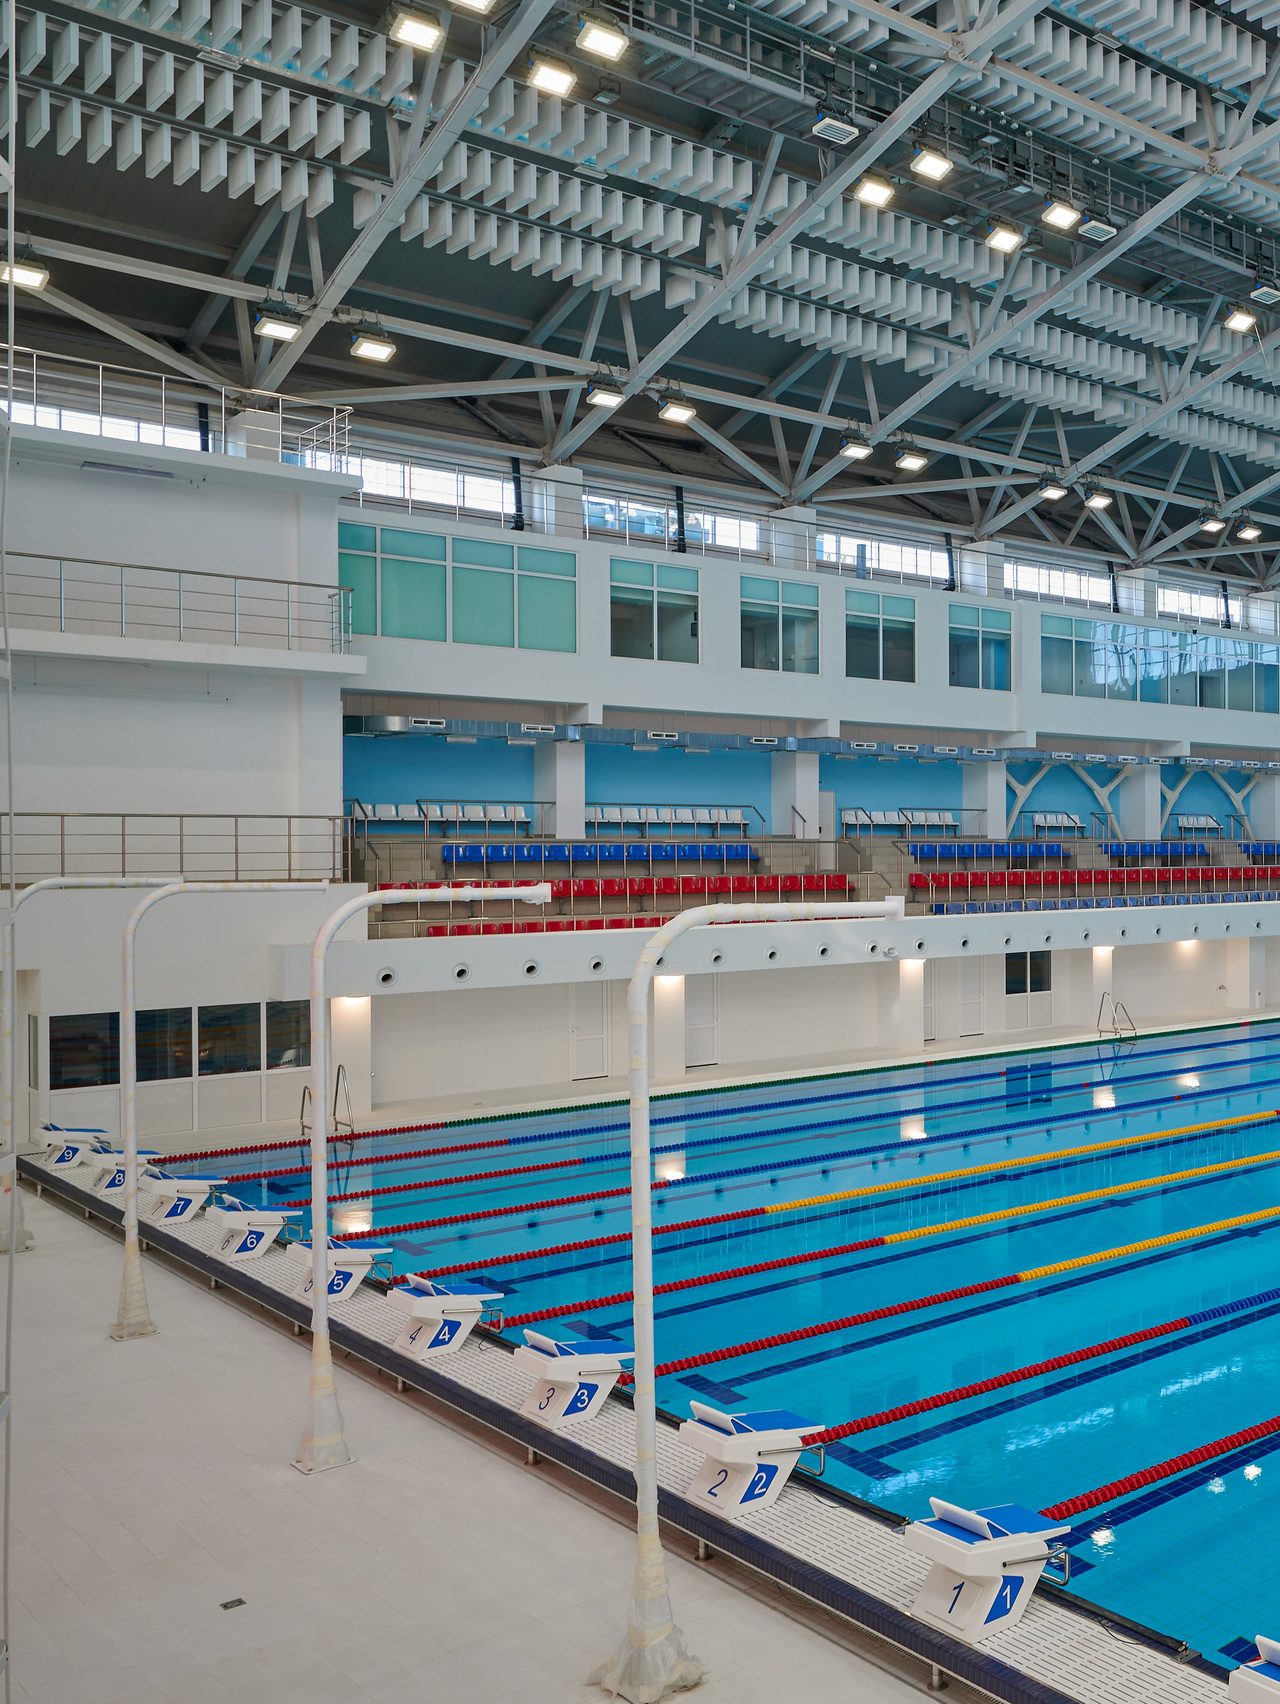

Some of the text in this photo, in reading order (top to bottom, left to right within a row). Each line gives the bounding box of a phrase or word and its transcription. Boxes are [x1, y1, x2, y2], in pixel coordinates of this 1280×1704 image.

[64, 1149, 73, 1160] 9
[115, 1173, 124, 1185] 8
[175, 1201, 185, 1214] 7
[221, 1234, 234, 1251] 6
[246, 1234, 257, 1248] 6
[333, 1275, 344, 1291] 5
[409, 1325, 423, 1345] 4
[438, 1325, 450, 1342] 4
[538, 1387, 555, 1410] 3
[577, 1389, 589, 1408] 3
[707, 1468, 728, 1498] 2
[754, 1472, 767, 1495] 2
[948, 1581, 965, 1614] 1
[1002, 1584, 1011, 1610] 1
